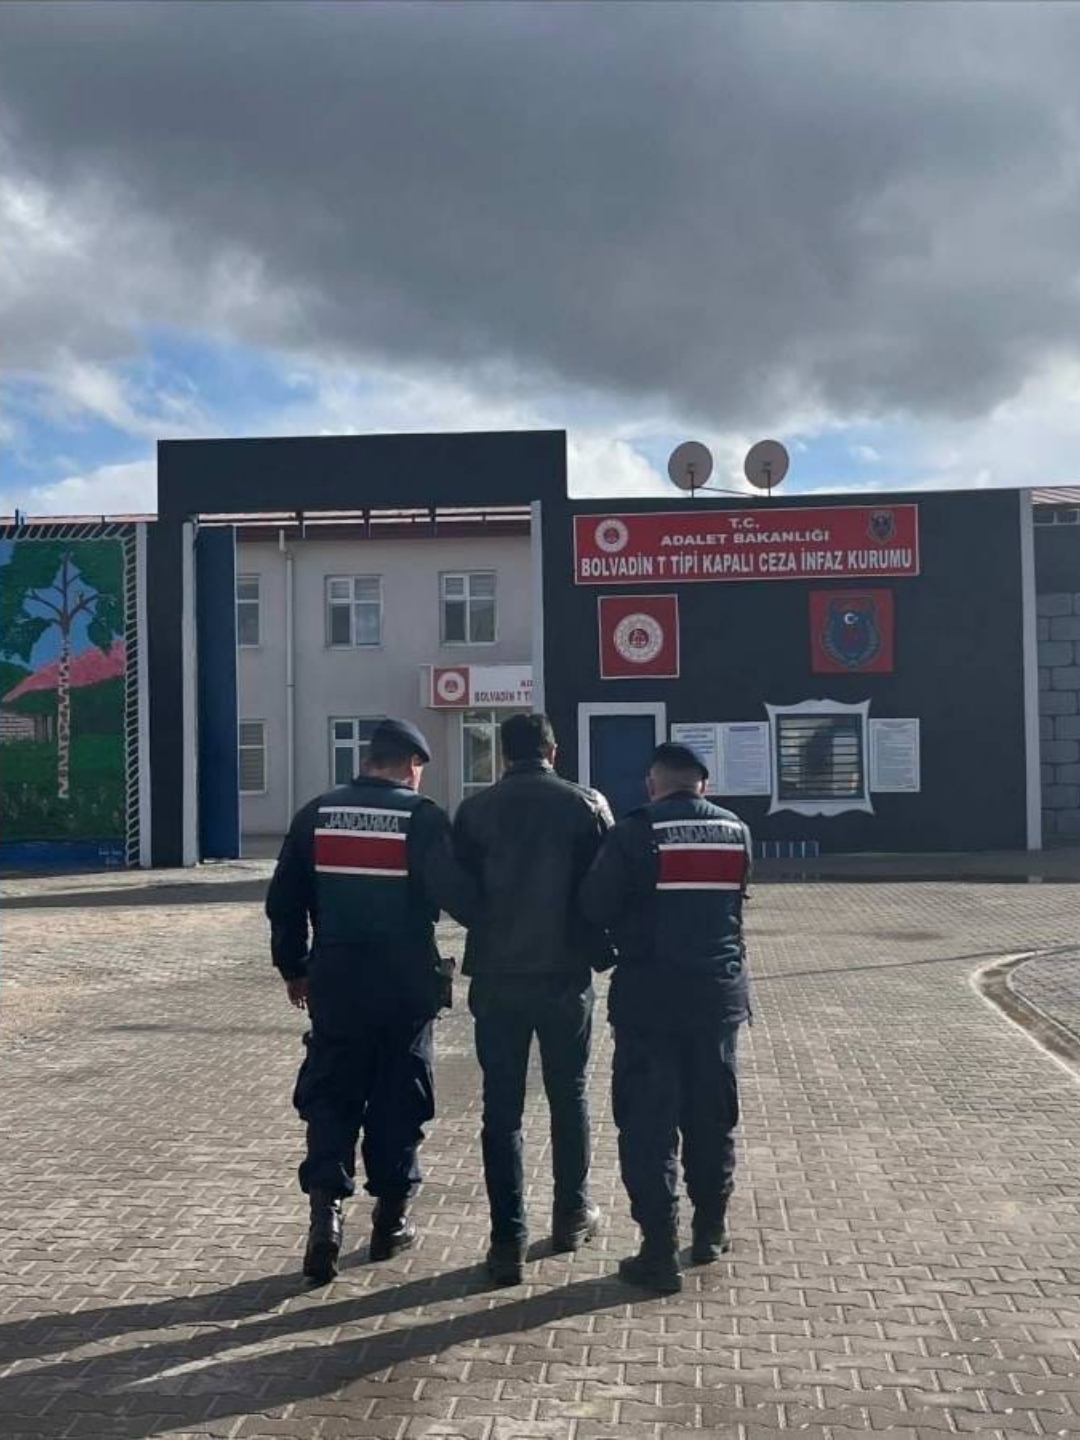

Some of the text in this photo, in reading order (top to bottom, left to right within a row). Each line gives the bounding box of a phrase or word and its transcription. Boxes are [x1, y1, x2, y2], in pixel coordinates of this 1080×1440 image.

[728, 518, 760, 529] T.C.
[660, 530, 829, 546] ADALET BAKANLIĞI
[581, 548, 912, 576] BOLVADİN T TİPİ KAPALI CEZA İNFAZ KURUMU
[325, 812, 400, 832] JANDARMA
